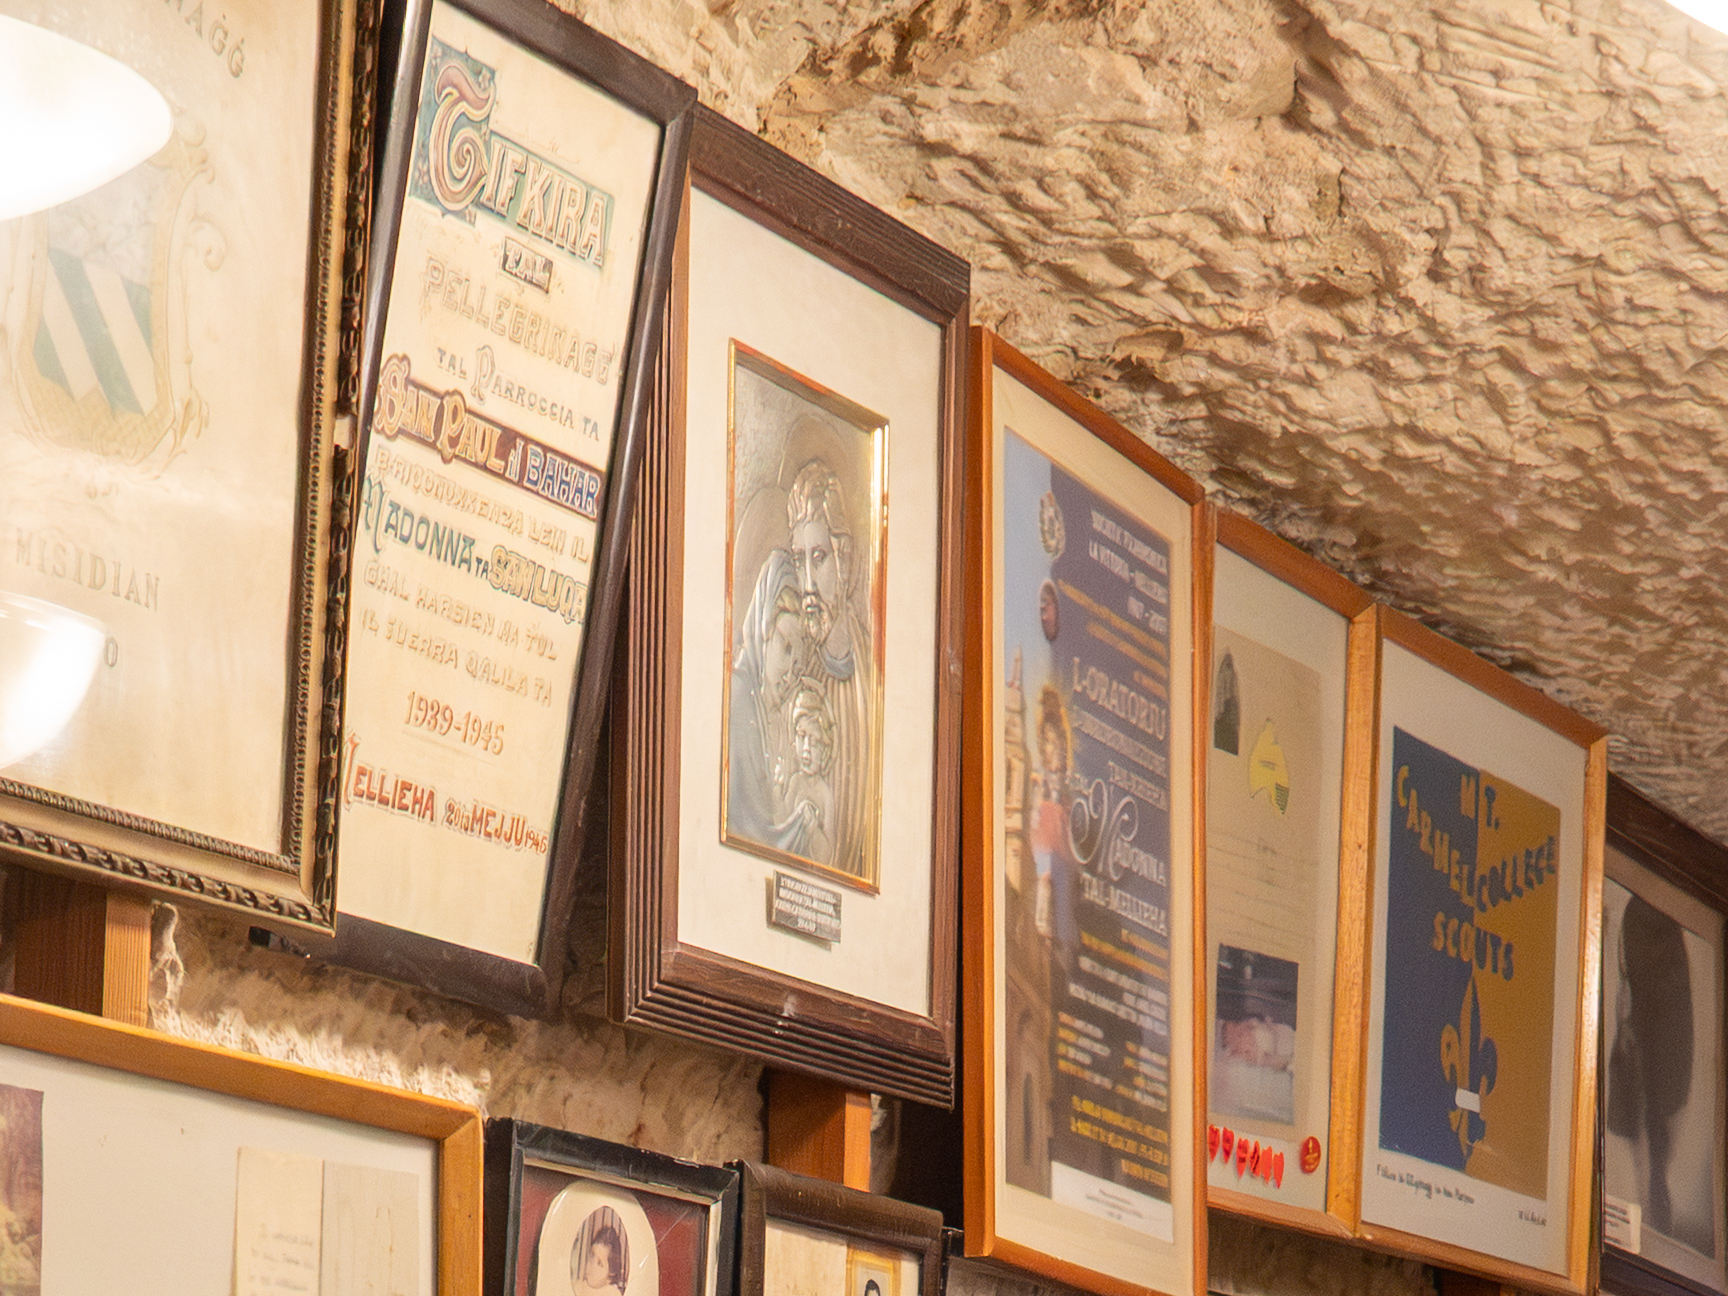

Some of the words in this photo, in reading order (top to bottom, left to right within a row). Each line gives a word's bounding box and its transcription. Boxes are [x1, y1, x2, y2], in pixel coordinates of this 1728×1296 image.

[429, 64, 607, 268] TIFKIRA
[437, 348, 467, 379] TAL
[364, 473, 475, 578] MADONNA
[405, 690, 505, 756] 1939-1945
[471, 803, 525, 848] MEJJU
[1460, 773, 1501, 832] MT.
[1396, 765, 1475, 908] CARMEL
[1475, 834, 1556, 914] COLLEGE
[1432, 910, 1515, 982] SCOUTS
